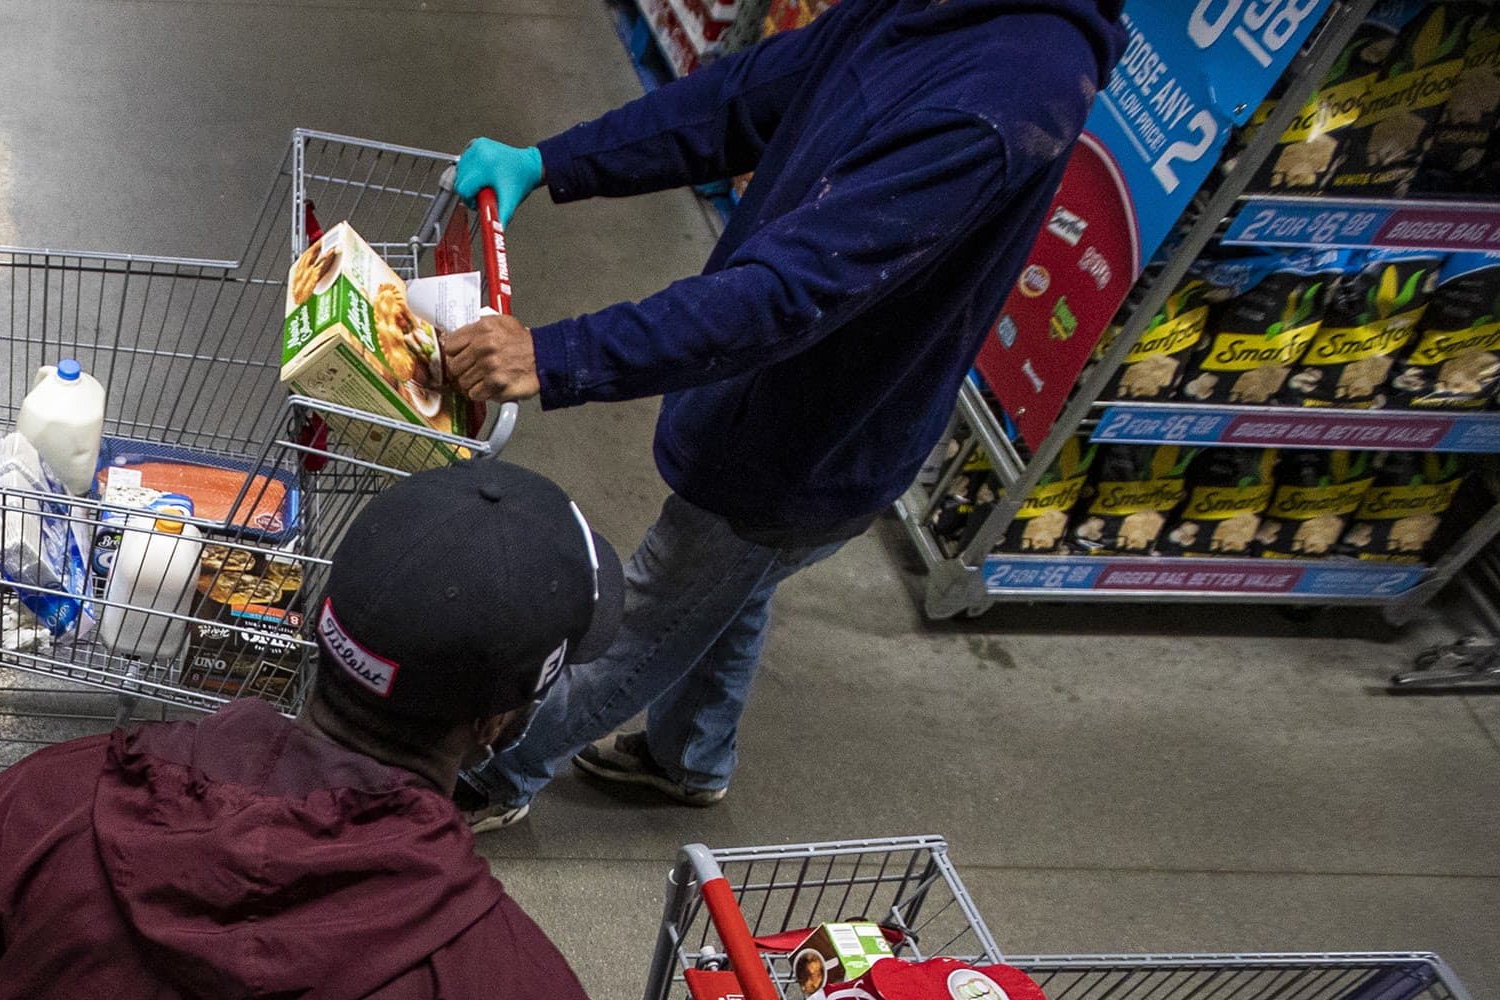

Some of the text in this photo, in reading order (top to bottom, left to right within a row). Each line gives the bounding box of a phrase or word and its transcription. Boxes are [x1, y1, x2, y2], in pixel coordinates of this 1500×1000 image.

[1149, 77, 1218, 195] ANY 2
[1238, 209, 1277, 241] 2
[1266, 218, 1307, 235] FOR
[1386, 221, 1450, 240] BIGGER
[1101, 412, 1133, 438] 2
[1123, 419, 1161, 435] FOR
[1321, 425, 1389, 441] BETTER
[1384, 426, 1441, 443] VALUE
[985, 564, 1011, 587] 2
[1006, 568, 1041, 583] FOR
[1104, 571, 1157, 585] BIGGER
[1186, 572, 1246, 587] BETTER
[1242, 573, 1292, 587] VALUE
[288, 614, 299, 625] 8
[321, 617, 387, 686] Titleist
[194, 656, 227, 670] UNO
